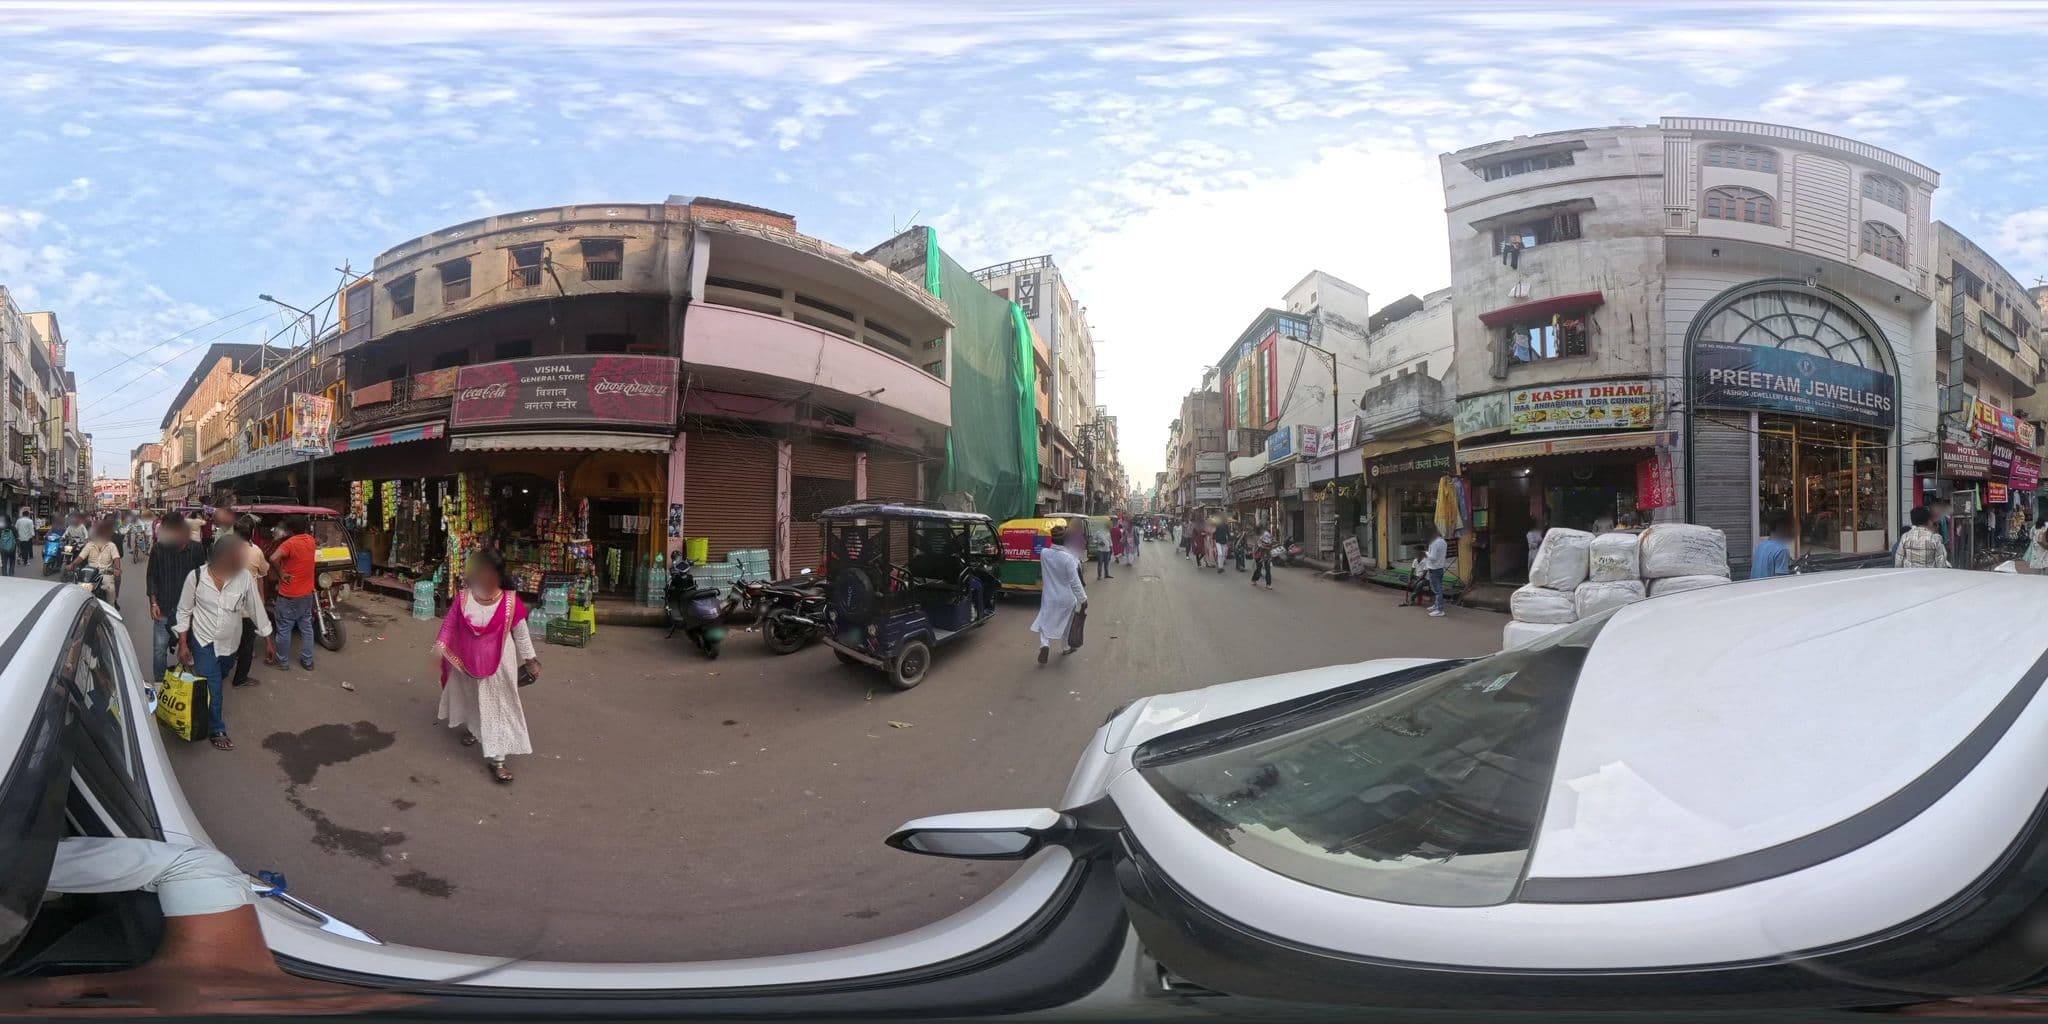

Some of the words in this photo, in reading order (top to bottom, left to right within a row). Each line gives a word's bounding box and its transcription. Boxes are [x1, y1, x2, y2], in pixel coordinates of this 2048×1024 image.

[534, 365, 571, 373] VISHAL
[520, 374, 557, 383] GENERAL
[535, 387, 568, 397] विशाल
[1531, 388, 1583, 403] KASHI
[1589, 385, 1644, 398] DHAM
[1709, 368, 1800, 394] PREETAM
[1806, 379, 1891, 411] JEWELLERS
[524, 400, 552, 410] जनरल
[556, 397, 578, 410] स्टोर
[1513, 404, 1530, 413] MAA
[1586, 397, 1607, 407] DOSA
[1957, 446, 1980, 456] HOTEL
[1992, 445, 2013, 460] AYUSH
